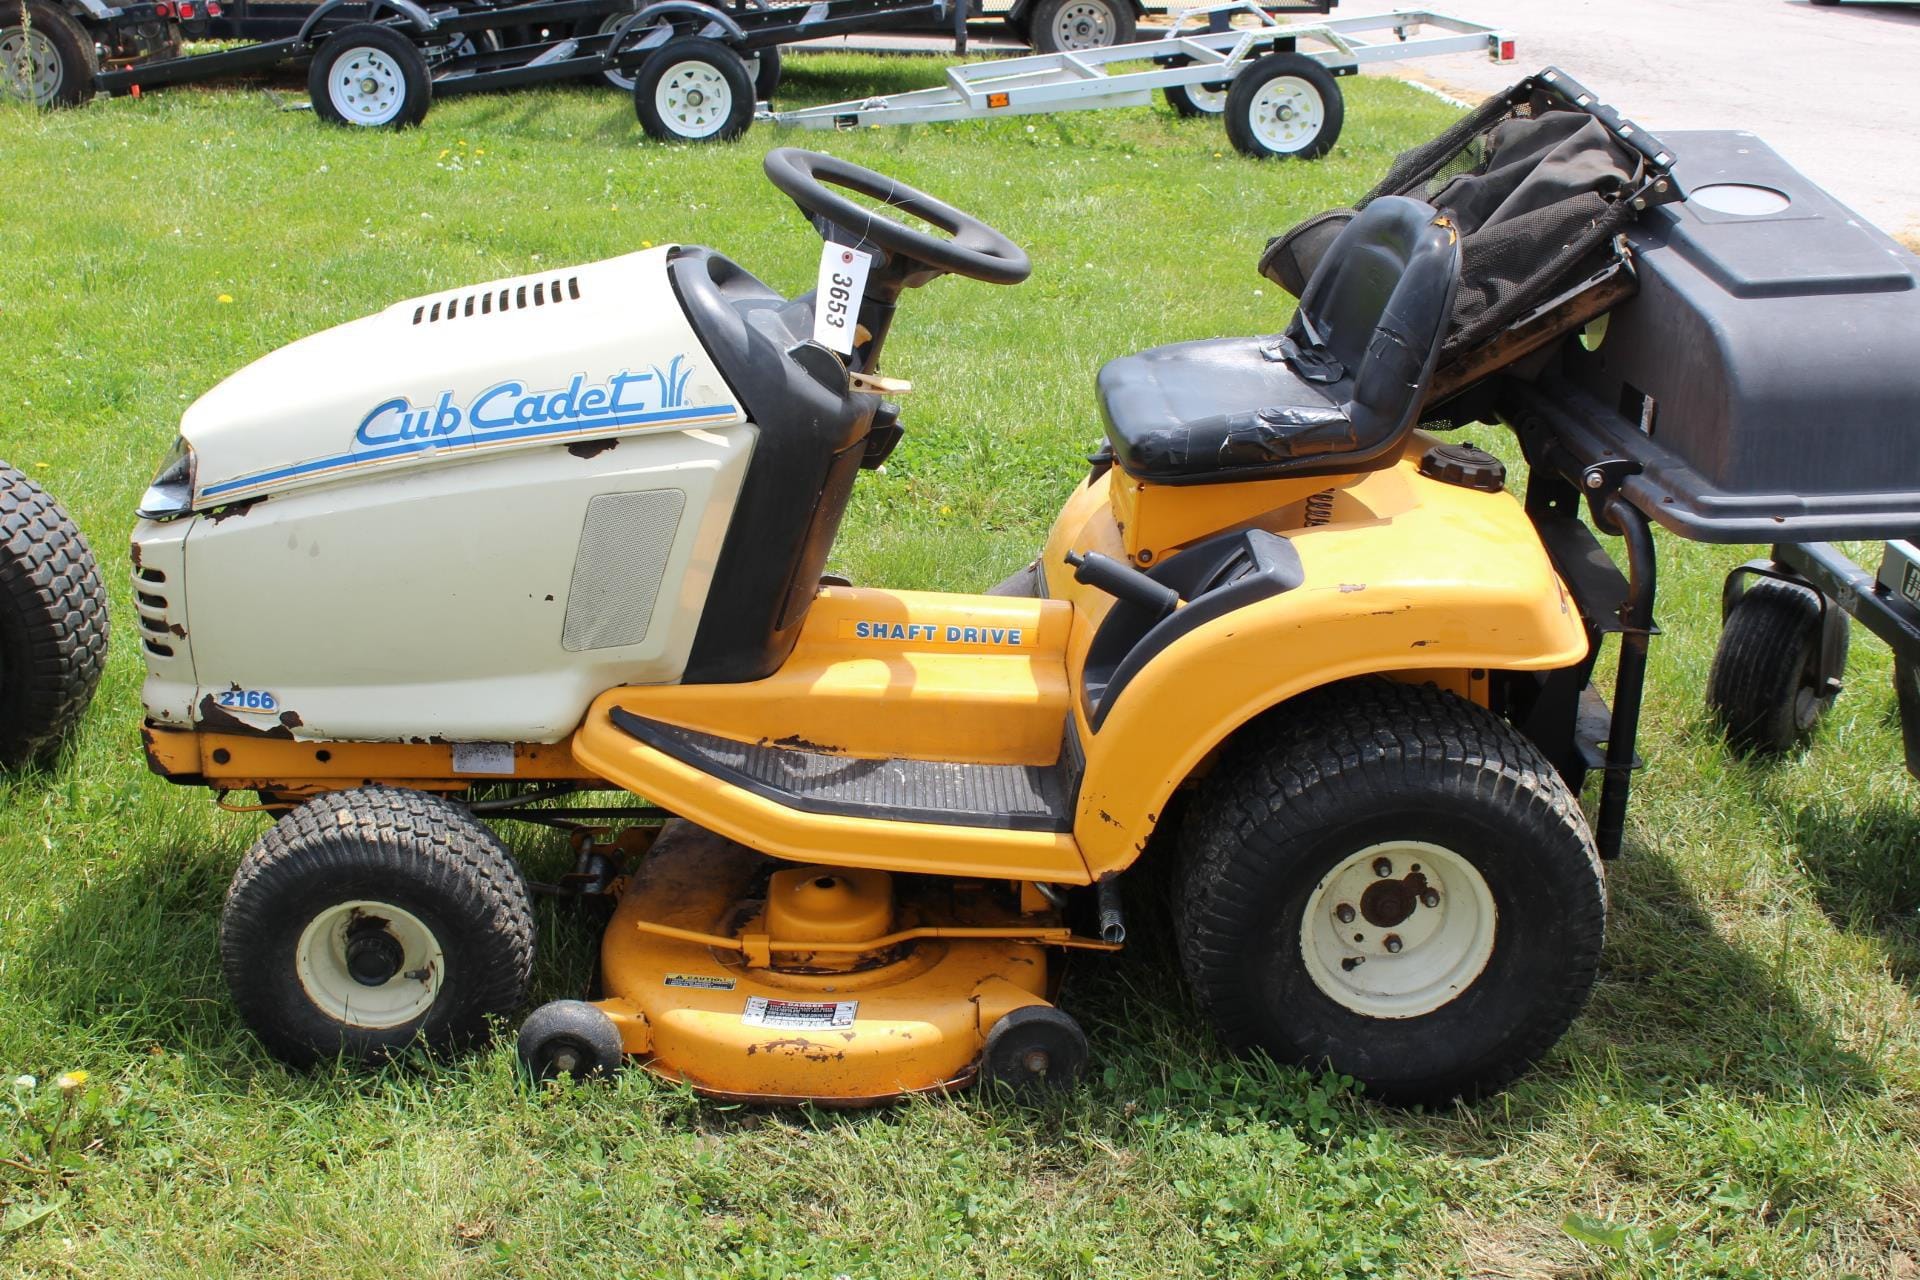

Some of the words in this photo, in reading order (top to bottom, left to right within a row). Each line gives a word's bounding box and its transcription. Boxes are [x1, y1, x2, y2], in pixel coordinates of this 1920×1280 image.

[825, 272, 854, 329] 3653
[356, 392, 461, 446] Cub
[470, 373, 653, 428] Cadet
[855, 621, 937, 641] SHAFT
[946, 626, 1022, 645] DRIVE
[220, 690, 275, 709] 2166
